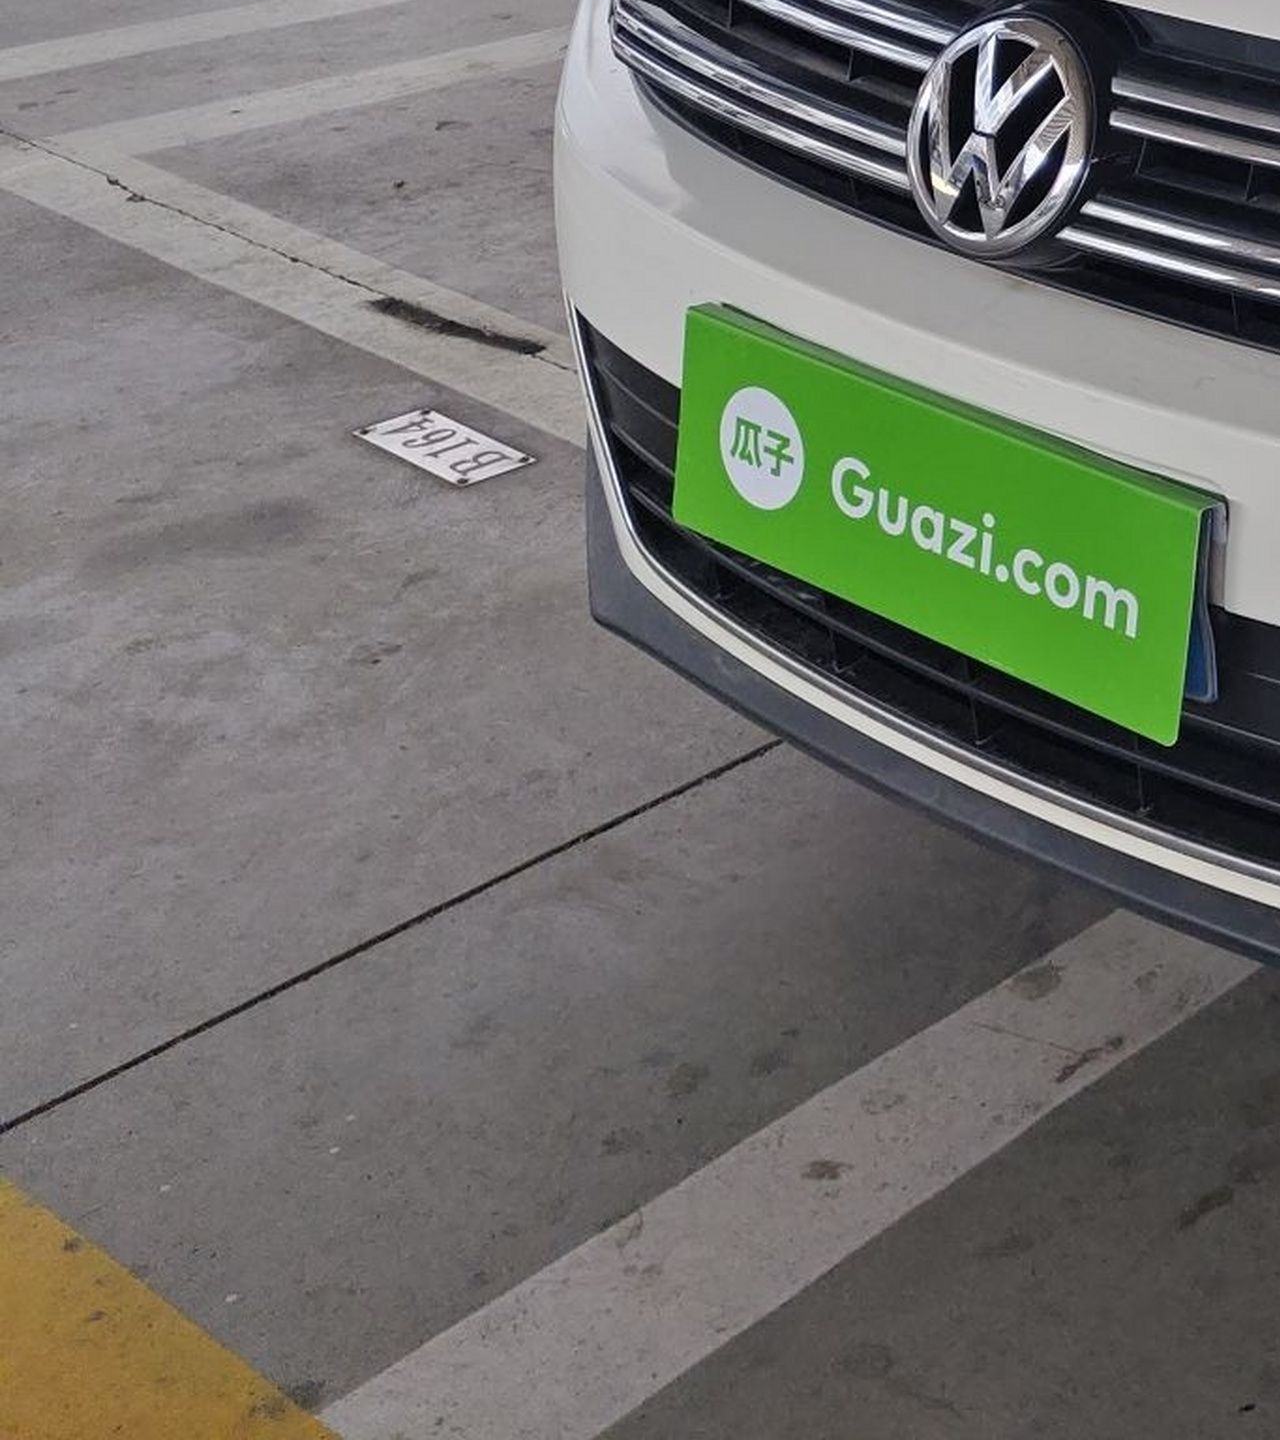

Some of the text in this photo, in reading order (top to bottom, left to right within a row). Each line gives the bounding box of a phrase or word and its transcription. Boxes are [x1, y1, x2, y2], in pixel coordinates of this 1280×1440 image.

[380, 417, 515, 477] B164
[730, 416, 795, 477] 瓜子
[831, 456, 1140, 639] Guazi.com
